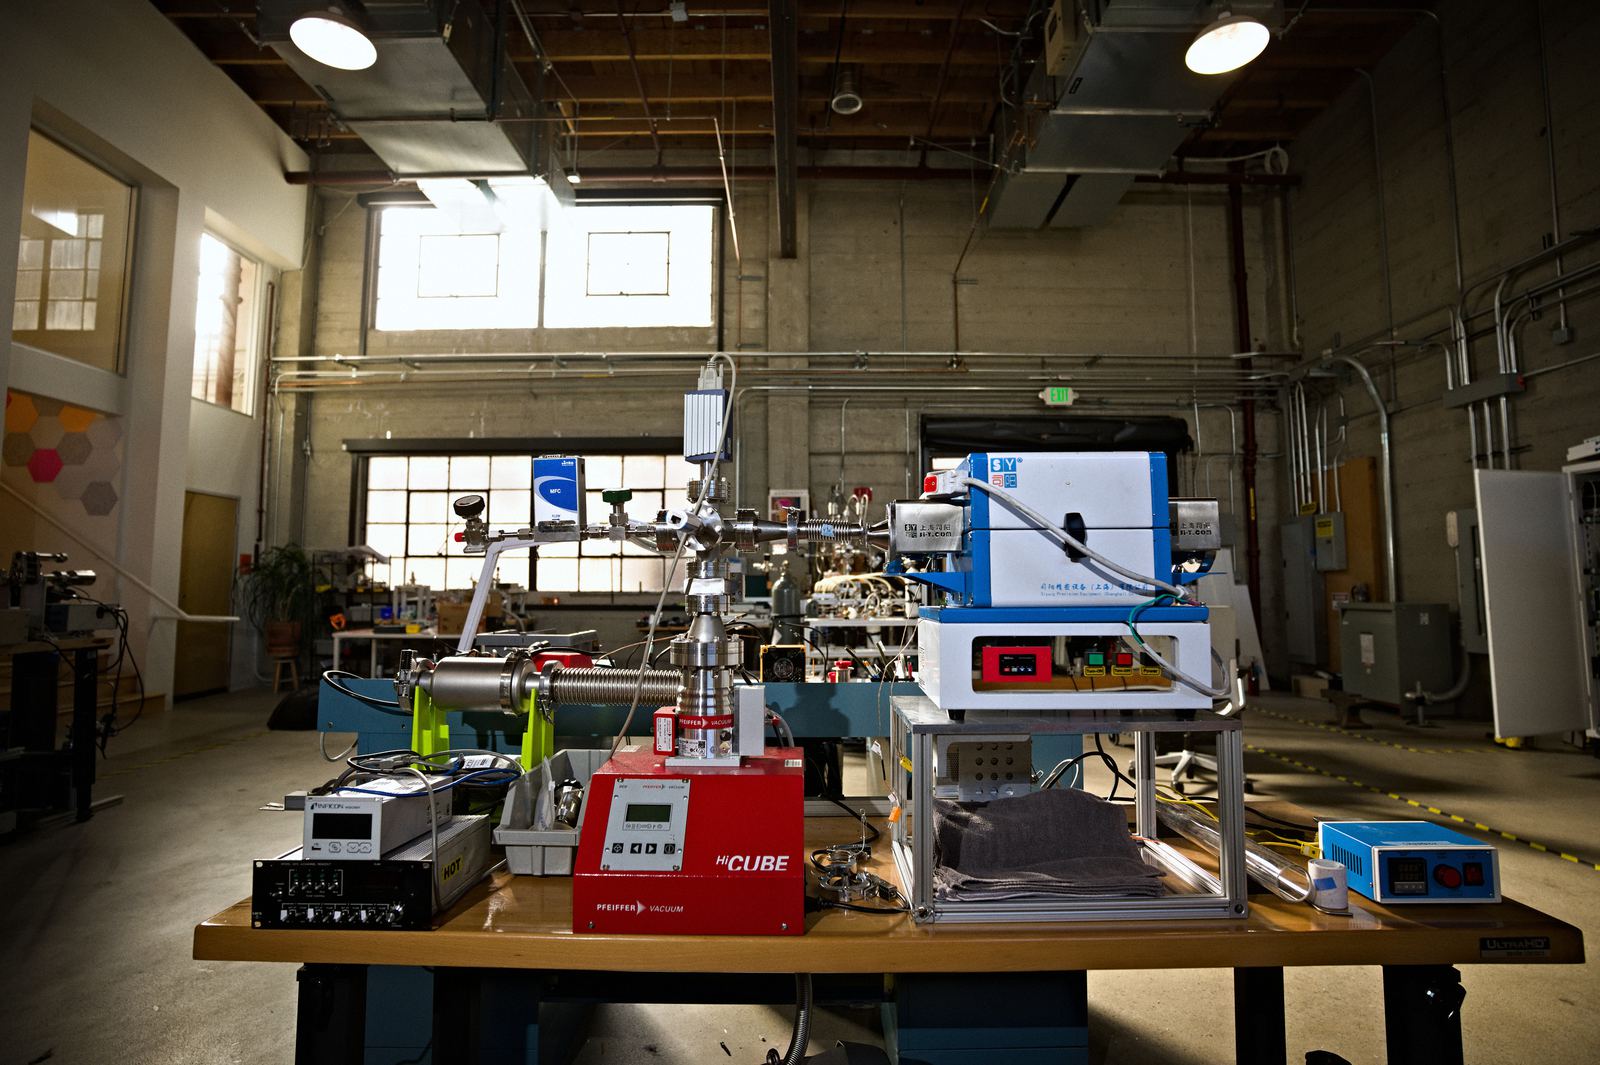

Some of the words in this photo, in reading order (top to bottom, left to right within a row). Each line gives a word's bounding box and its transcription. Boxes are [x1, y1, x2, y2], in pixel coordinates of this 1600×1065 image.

[1050, 387, 1069, 402] EXIT
[711, 718, 732, 726] VACUUM
[443, 858, 462, 880] HOT
[716, 855, 790, 872] HiCUBE
[596, 903, 636, 912] PFEIFFER
[649, 905, 684, 913] VACUUM
